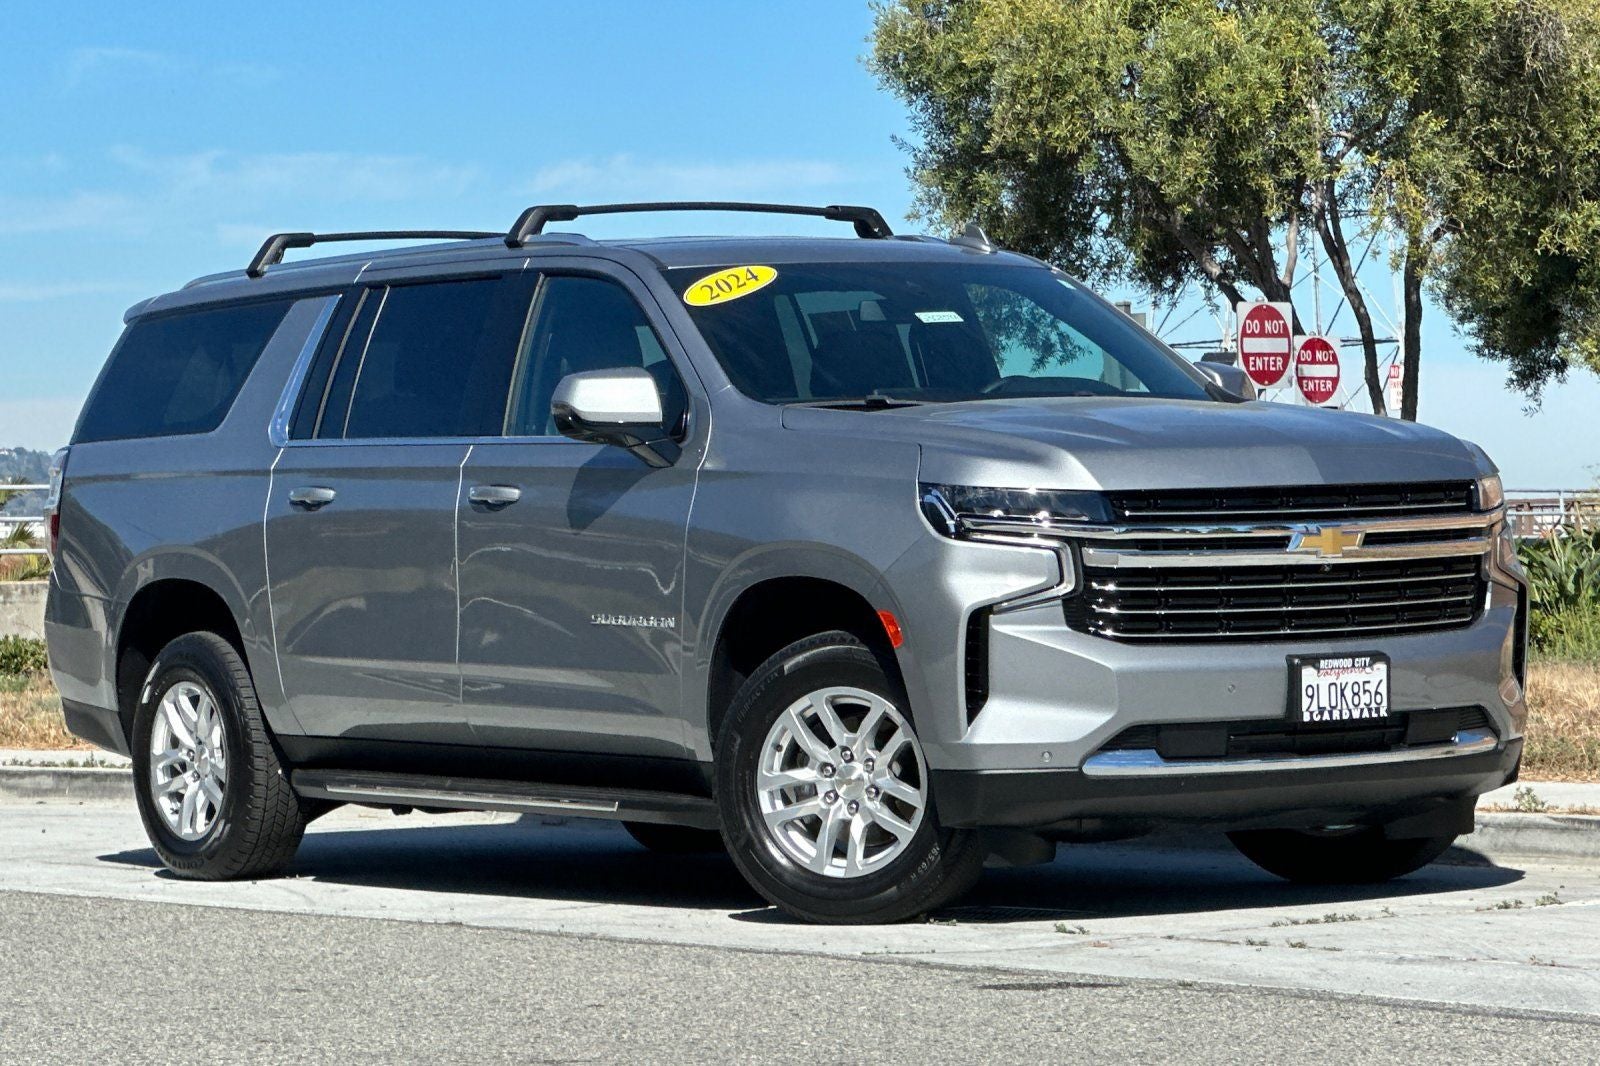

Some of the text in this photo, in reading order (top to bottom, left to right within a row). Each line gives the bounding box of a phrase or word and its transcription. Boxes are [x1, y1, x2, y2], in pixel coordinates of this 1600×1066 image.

[700, 267, 760, 300] 2024
[1245, 320, 1285, 334] DO NOT
[1300, 350, 1334, 362] DO NOT
[1249, 356, 1283, 372] ENTER
[1302, 380, 1333, 392] ENTER
[1319, 657, 1371, 668] REDWOOD CITY
[1302, 706, 1388, 722] BOARDWALK
